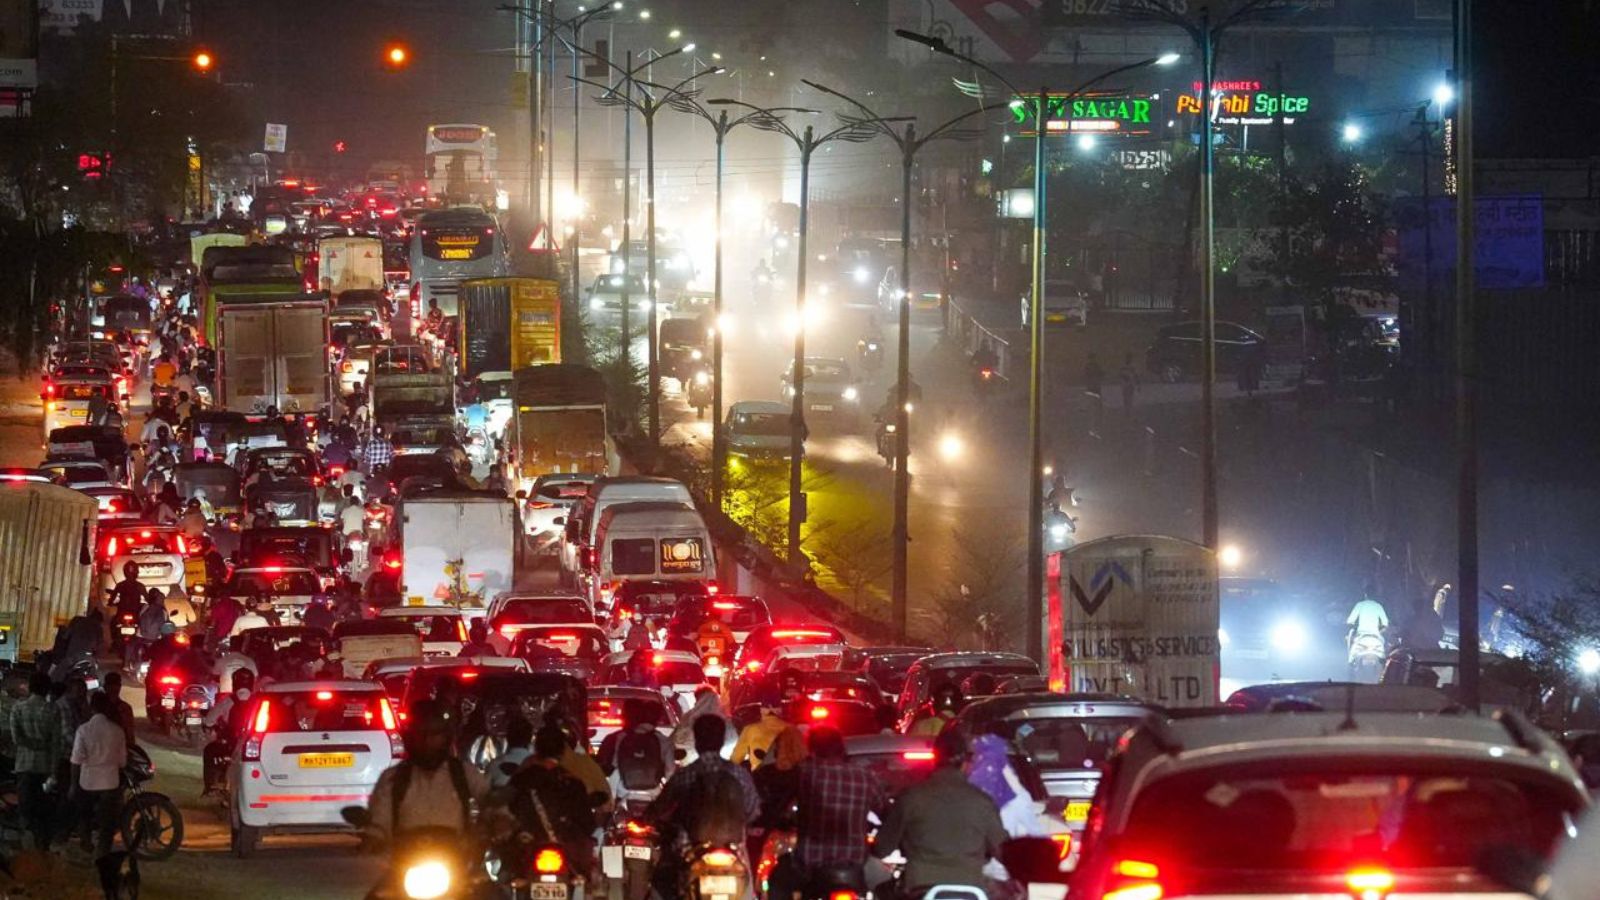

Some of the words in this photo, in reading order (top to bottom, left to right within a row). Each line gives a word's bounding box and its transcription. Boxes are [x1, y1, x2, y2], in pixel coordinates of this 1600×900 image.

[1071, 98, 1151, 123] SAGAR
[1255, 93, 1309, 117] Spice
[1158, 675, 1201, 700] LTD
